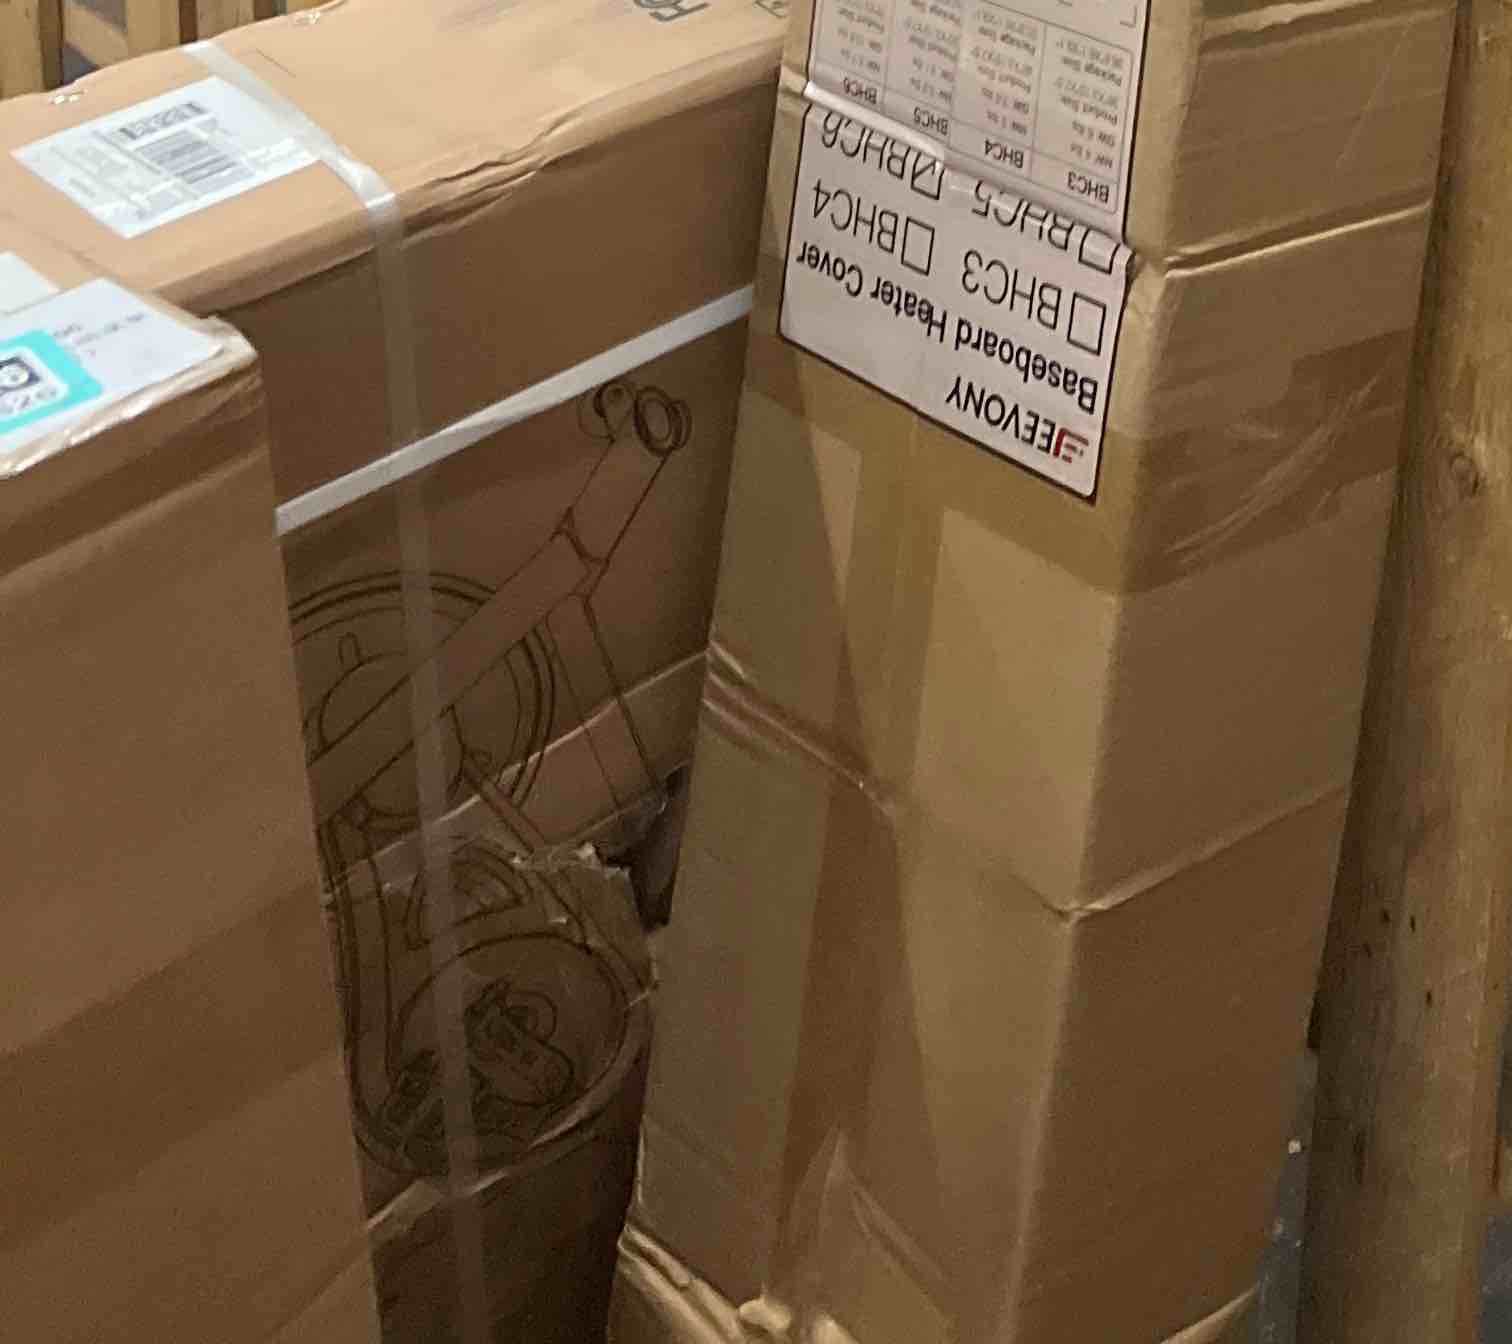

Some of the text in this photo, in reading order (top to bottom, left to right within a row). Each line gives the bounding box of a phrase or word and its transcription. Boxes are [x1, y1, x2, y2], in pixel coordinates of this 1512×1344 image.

[820, 109, 910, 183] BHC6
[985, 139, 1024, 168] BHC4
[813, 179, 898, 254] BHC4
[971, 178, 1074, 255] BHC5
[1068, 171, 1109, 204] BHC3
[962, 250, 1062, 330] BHC3
[796, 242, 1098, 415] Baseboard Heater Cover
